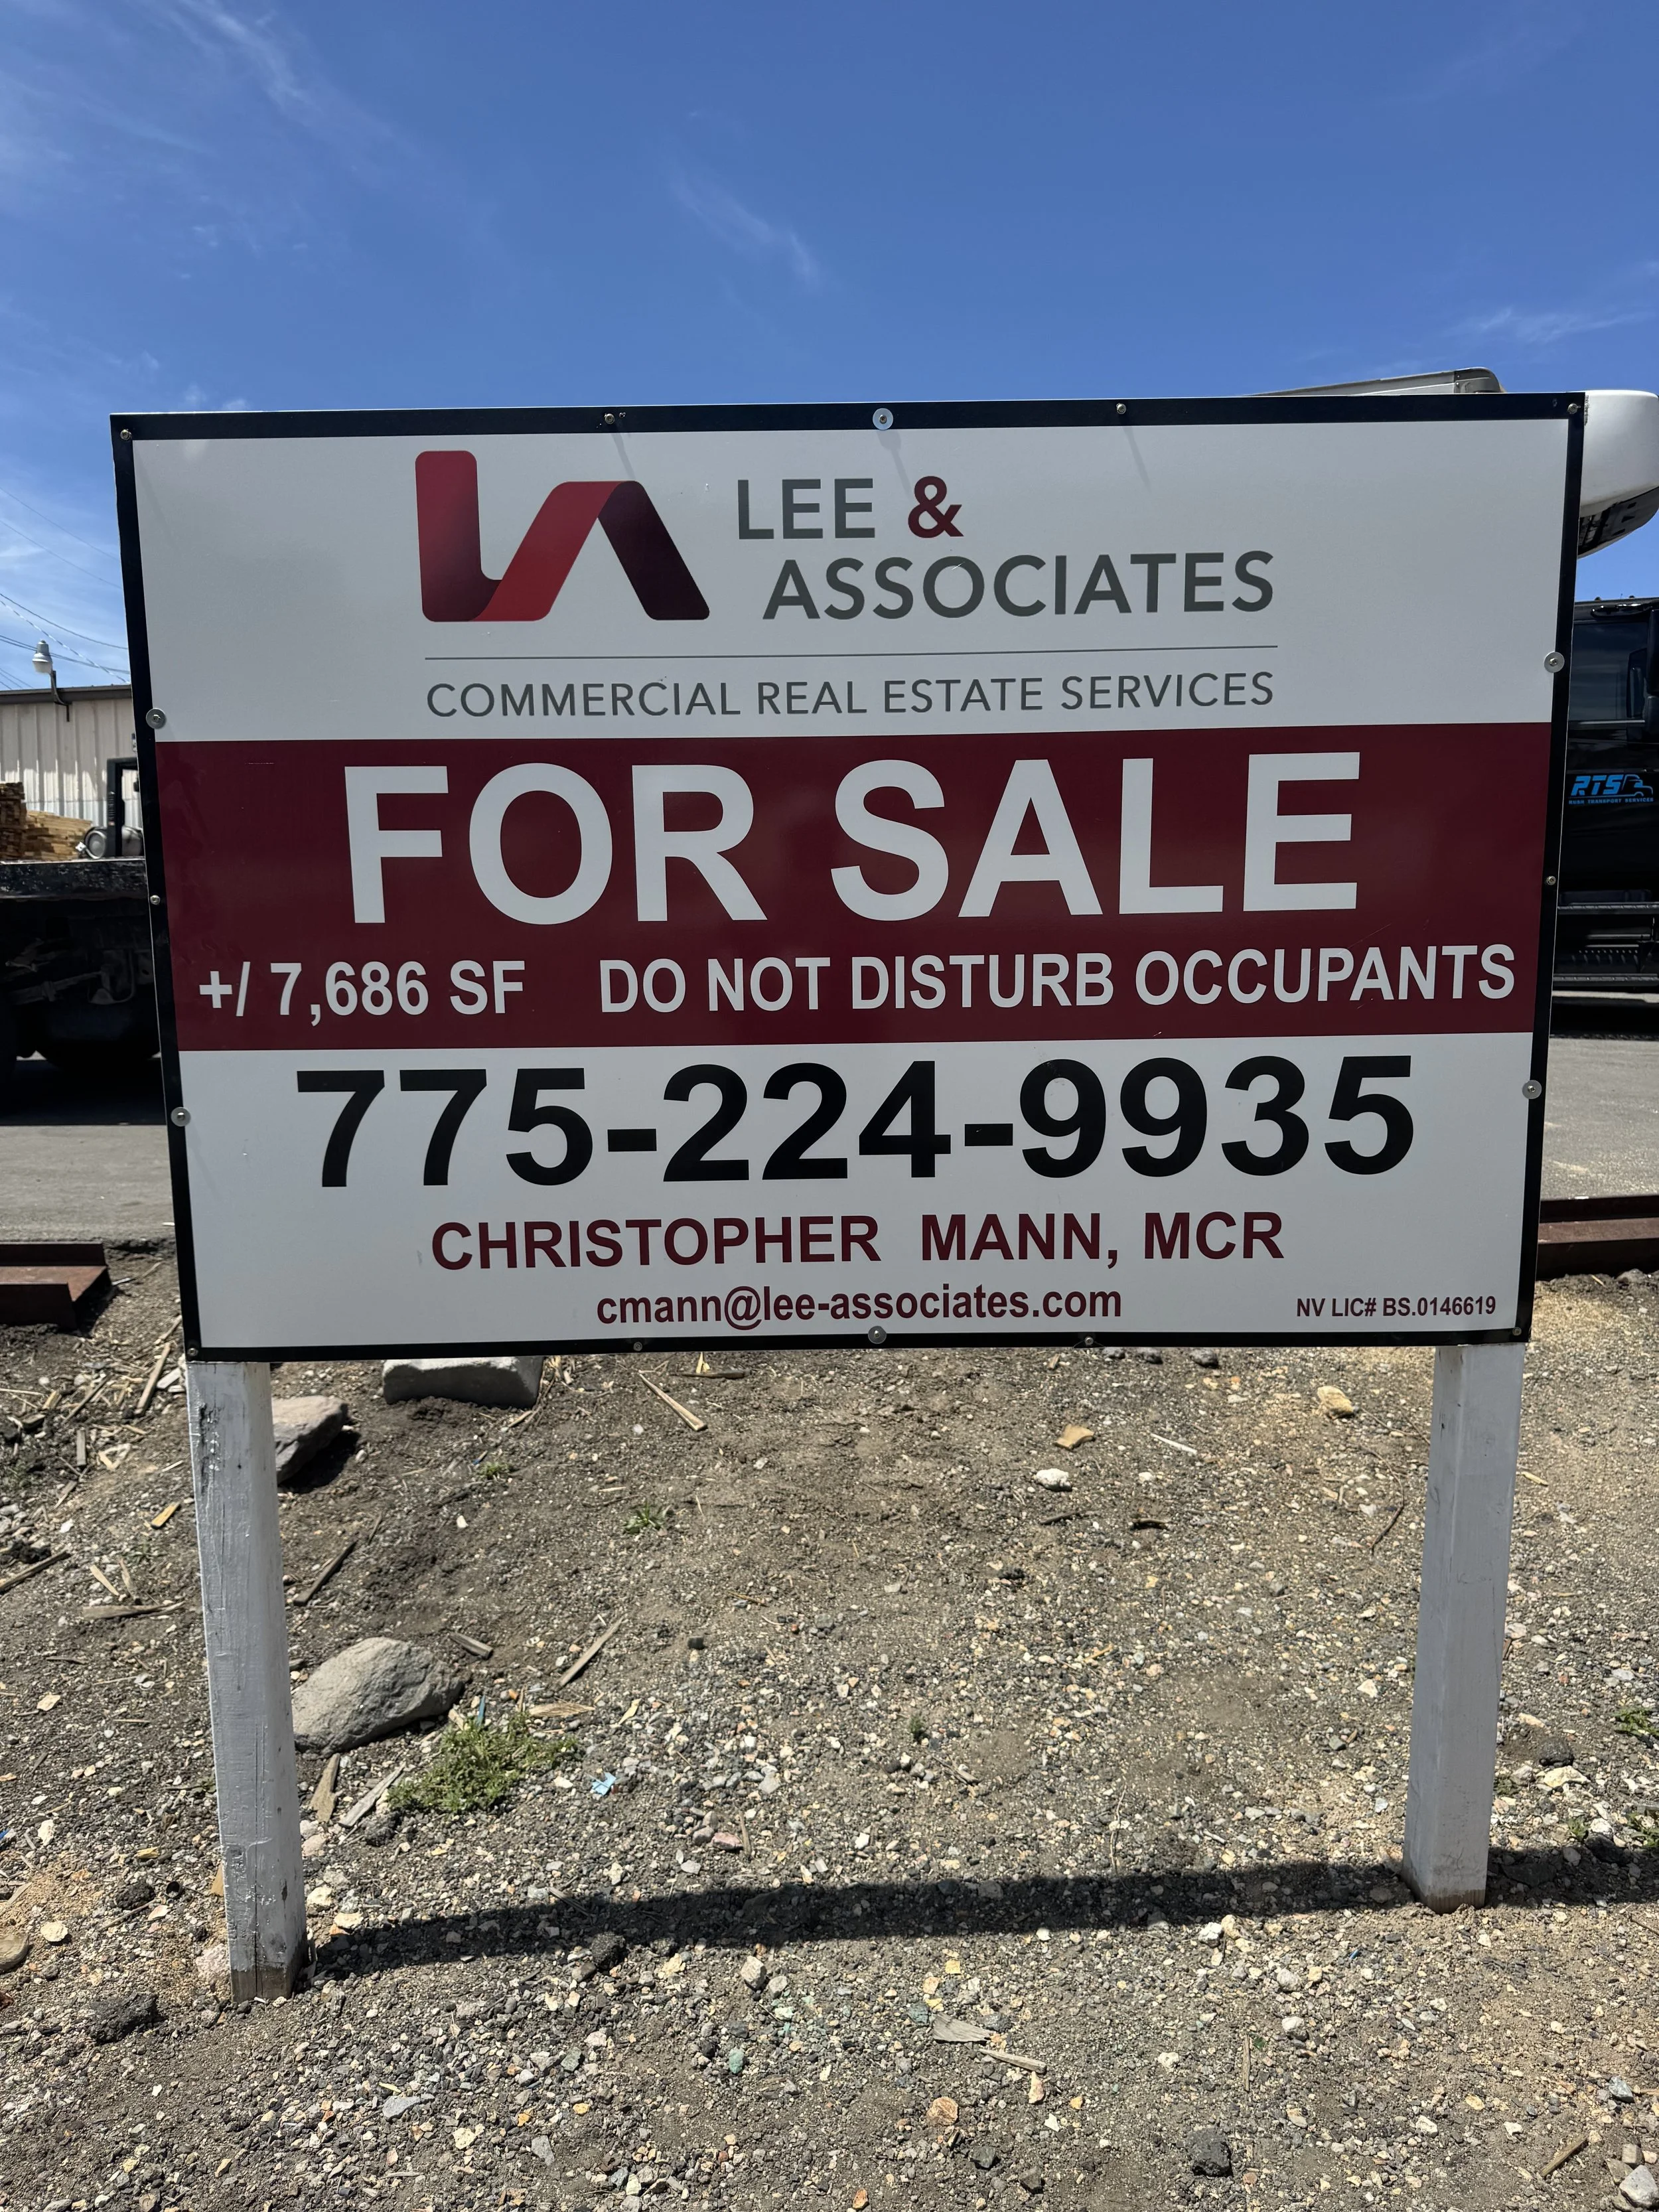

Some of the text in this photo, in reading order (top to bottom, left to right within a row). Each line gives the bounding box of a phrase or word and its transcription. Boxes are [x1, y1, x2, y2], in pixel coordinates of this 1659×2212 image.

[738, 476, 964, 540] LEE &
[762, 551, 1273, 619] ASSOCIATES
[427, 672, 1273, 717] COMMERCIAL REAL ESTATE SERVICES
[1570, 774, 1624, 796] RTS
[345, 752, 1360, 924] FOR SALE
[200, 960, 525, 1026] +/ 7,686 SF
[601, 944, 1514, 1012] DO NOT DISTURB OCCUPANTS
[297, 1056, 1413, 1187] 775-224-9935
[433, 1212, 1284, 1270] CHRISTOPHER MANN, MCR
[597, 1284, 1121, 1330] cmann@lee-associates.com
[1297, 1296, 1496, 1317] NV LIC# BS.0146619
